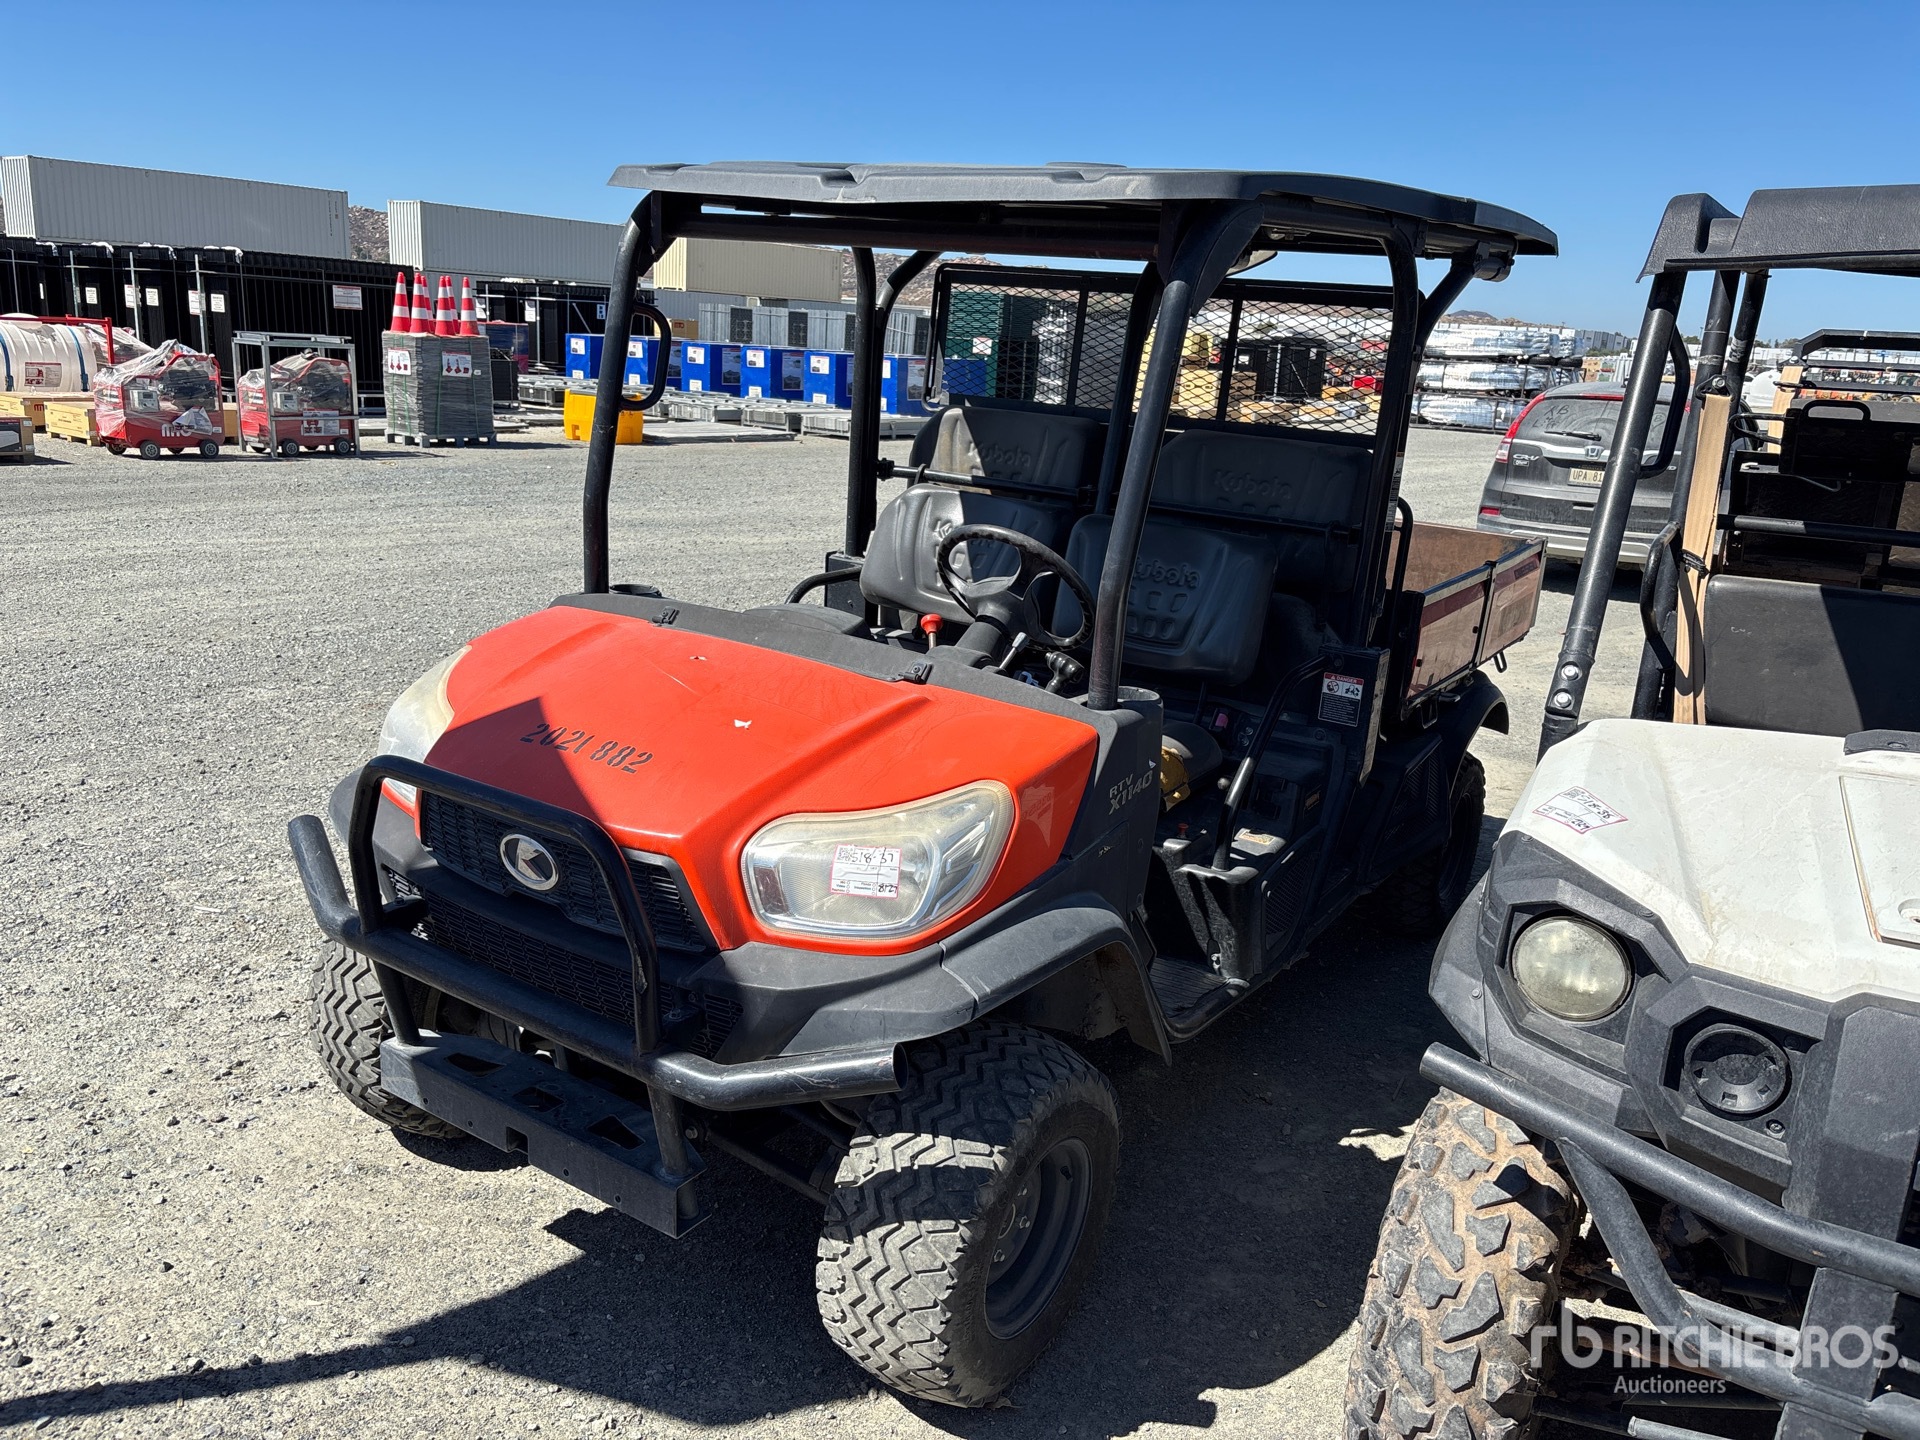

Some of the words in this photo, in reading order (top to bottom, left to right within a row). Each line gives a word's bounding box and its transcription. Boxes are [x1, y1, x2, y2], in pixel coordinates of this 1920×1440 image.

[1513, 453, 1540, 461] CR-V
[1572, 469, 1588, 481] UPA
[1592, 471, 1604, 483] 81
[1133, 557, 1200, 589] ubota
[1336, 675, 1357, 684] DANGER
[519, 723, 595, 754] 2021
[589, 740, 654, 774] 882
[1108, 770, 1154, 815] X1140
[1109, 773, 1133, 798] RTV
